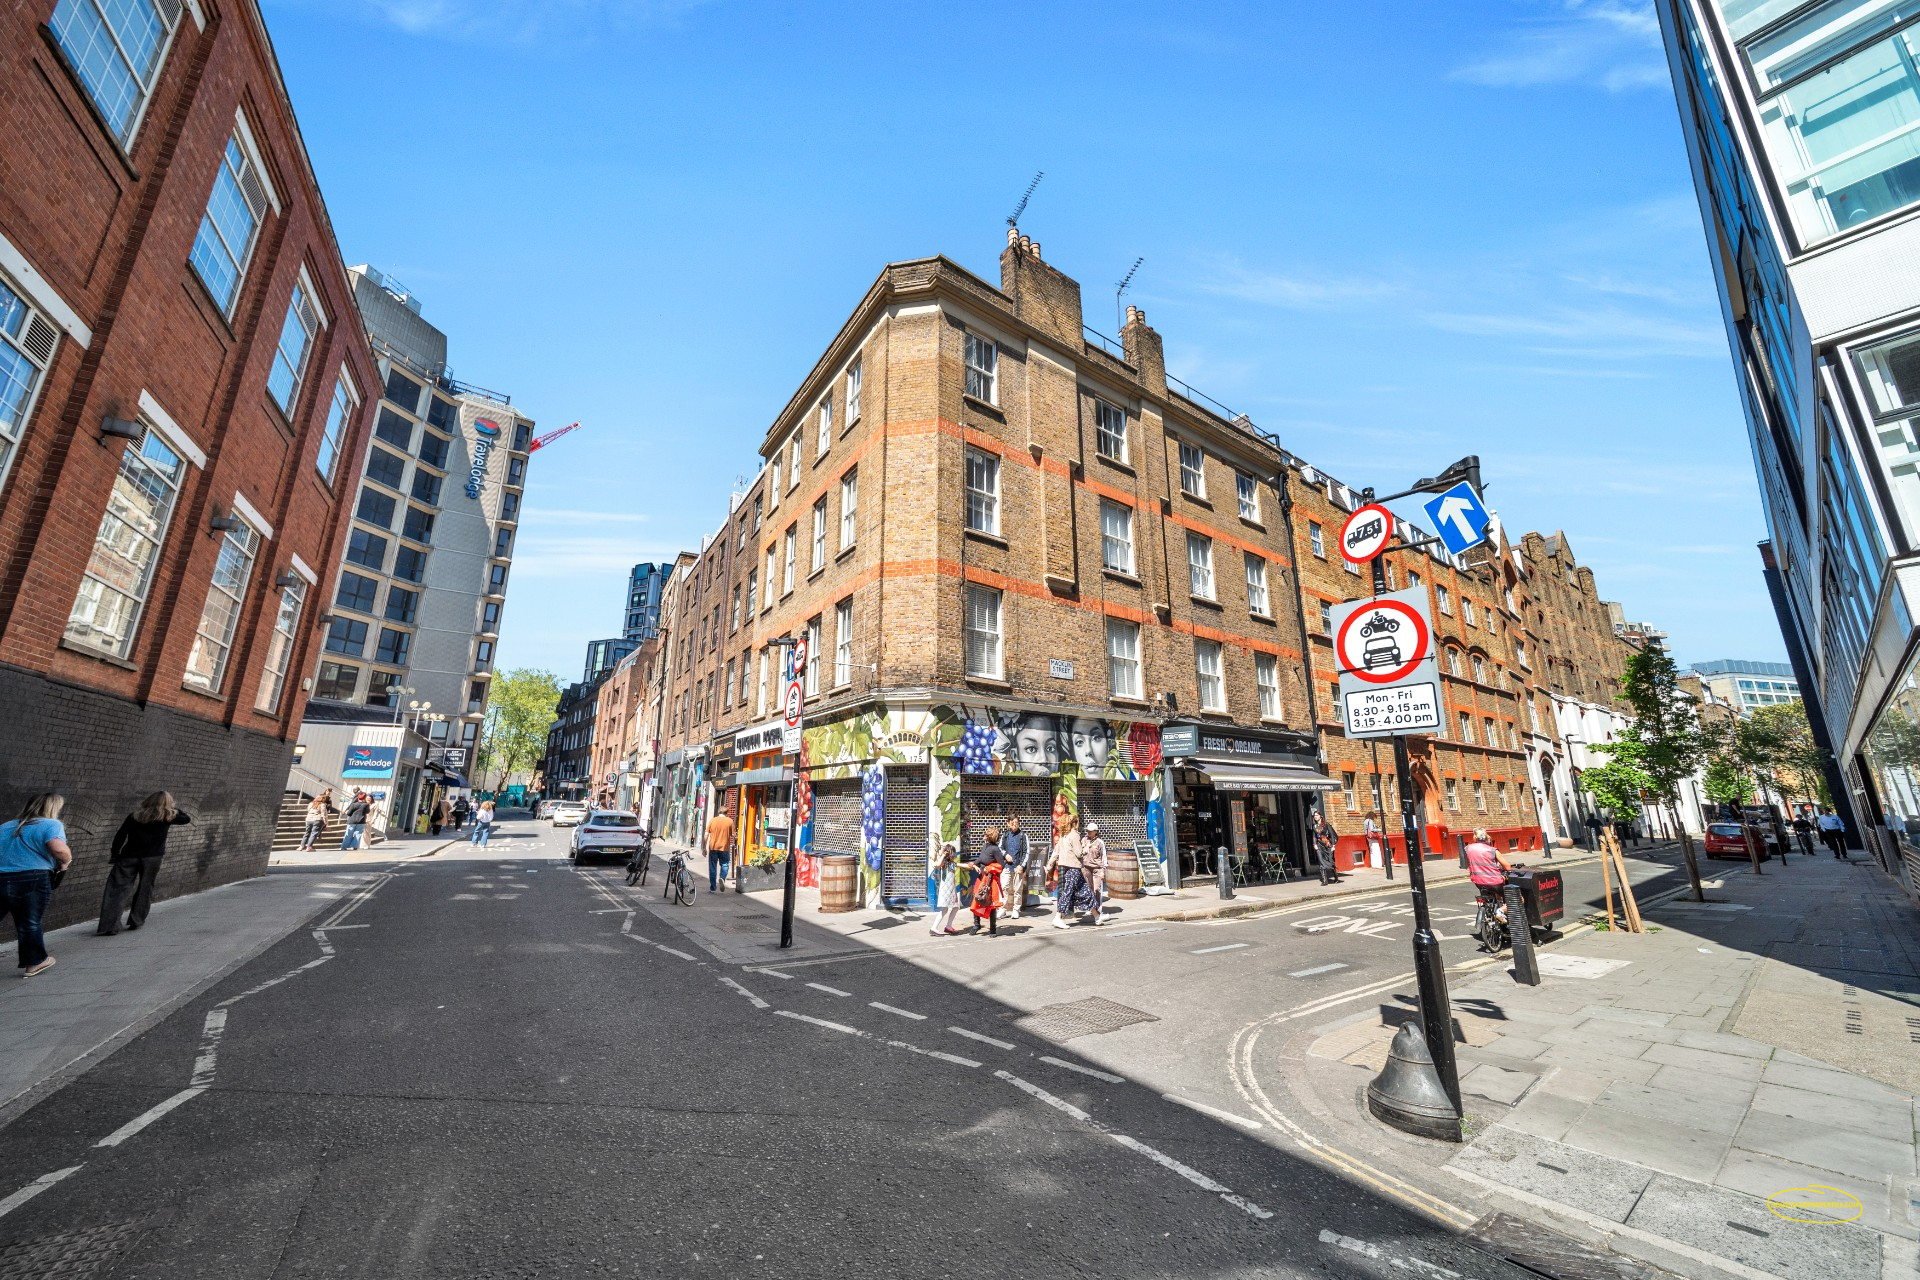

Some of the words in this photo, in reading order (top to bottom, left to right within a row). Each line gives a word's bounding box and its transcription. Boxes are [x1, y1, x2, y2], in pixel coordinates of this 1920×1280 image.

[464, 437, 493, 500] Travelodge
[1050, 660, 1072, 668] MACKLIN
[1366, 694, 1389, 704] Mon
[1397, 690, 1413, 700] Fri
[1353, 706, 1379, 717] 8.30
[1387, 703, 1410, 714] 9.15
[1412, 702, 1430, 711] am
[1354, 717, 1376, 728] 3.15
[1383, 714, 1412, 725] 4.00
[1414, 714, 1433, 724] pm
[1203, 736, 1226, 752] FRESH
[1235, 740, 1262, 754] ORGANIC
[347, 757, 392, 768] Travelodge
[910, 755, 923, 763] 175
